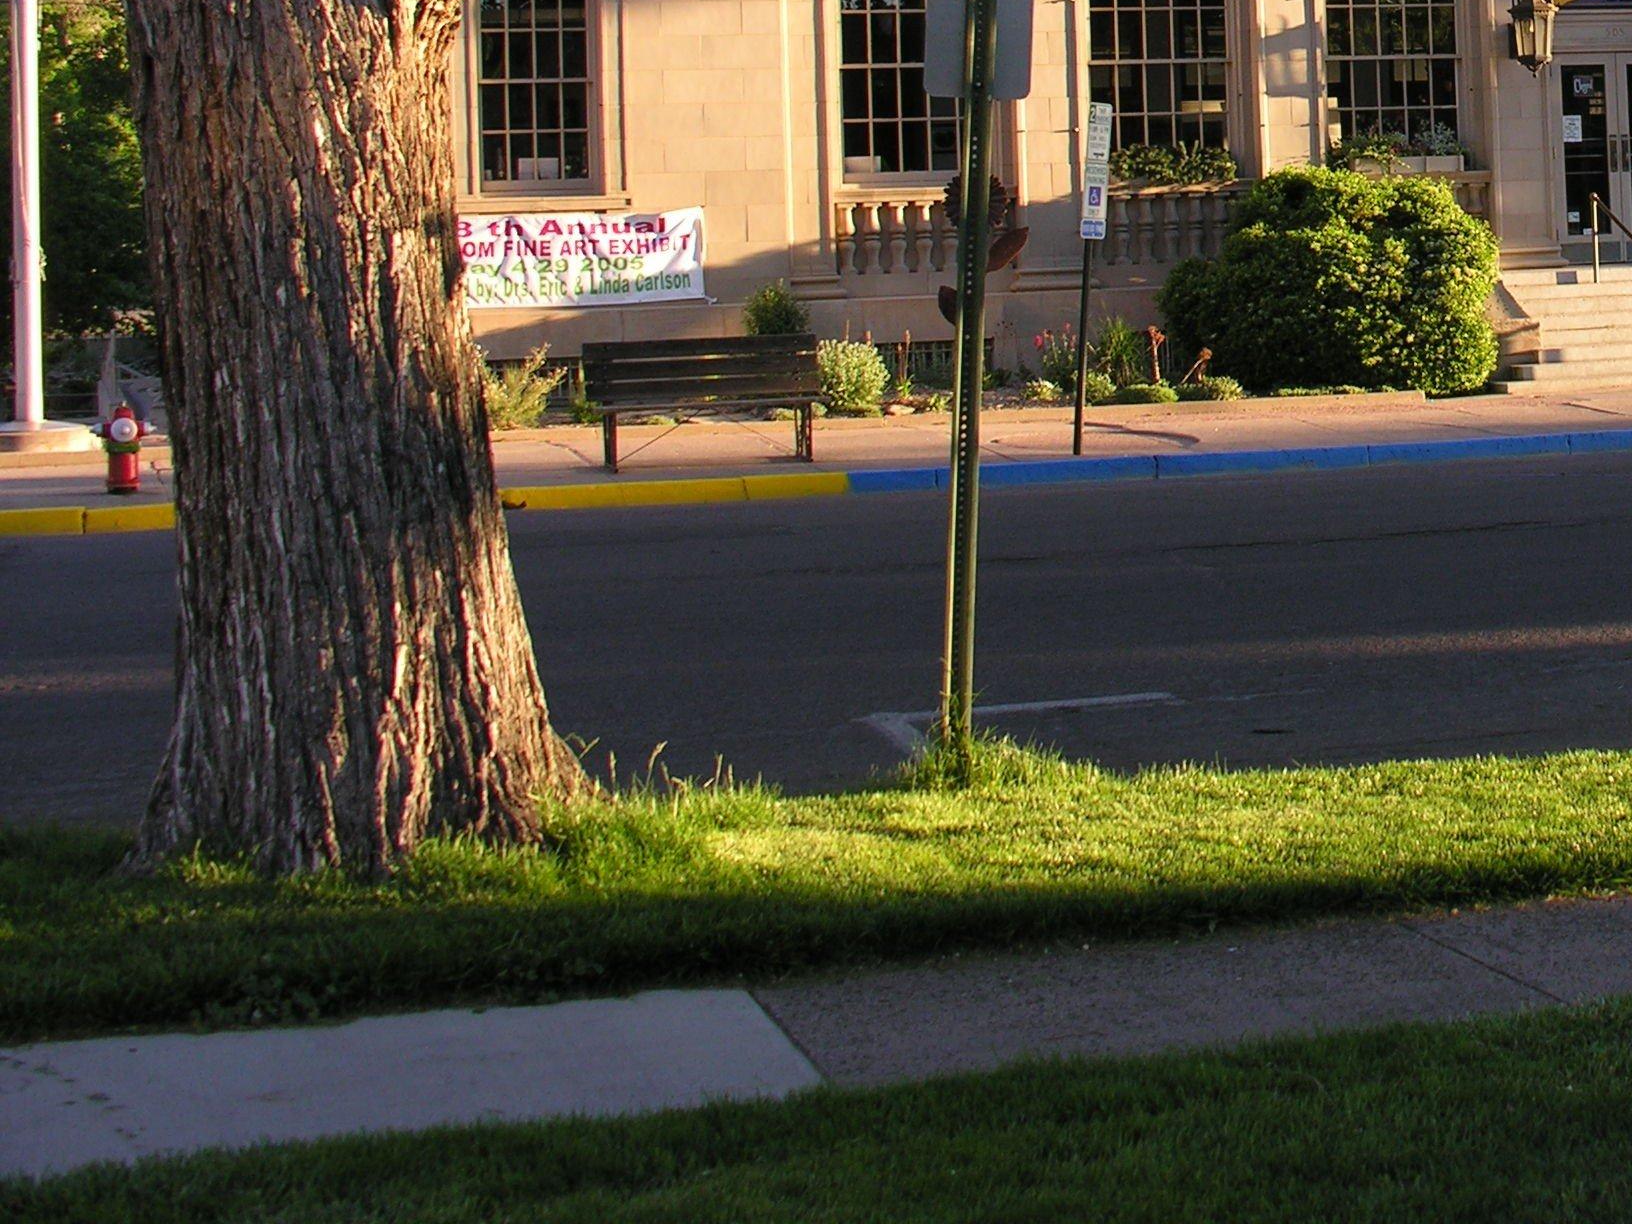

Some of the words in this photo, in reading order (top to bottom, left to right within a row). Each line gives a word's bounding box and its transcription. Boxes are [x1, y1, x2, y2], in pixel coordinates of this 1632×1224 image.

[487, 220, 523, 236] th
[539, 218, 665, 236] Annual
[504, 240, 551, 256] FINE
[560, 239, 599, 256] ART
[609, 232, 691, 255] EXHIBIT
[470, 264, 502, 277] ay
[581, 256, 644, 273] 2005
[540, 276, 567, 296] Eric
[574, 275, 584, 295] &
[589, 273, 630, 296] Linda
[635, 271, 692, 292] Carlson
